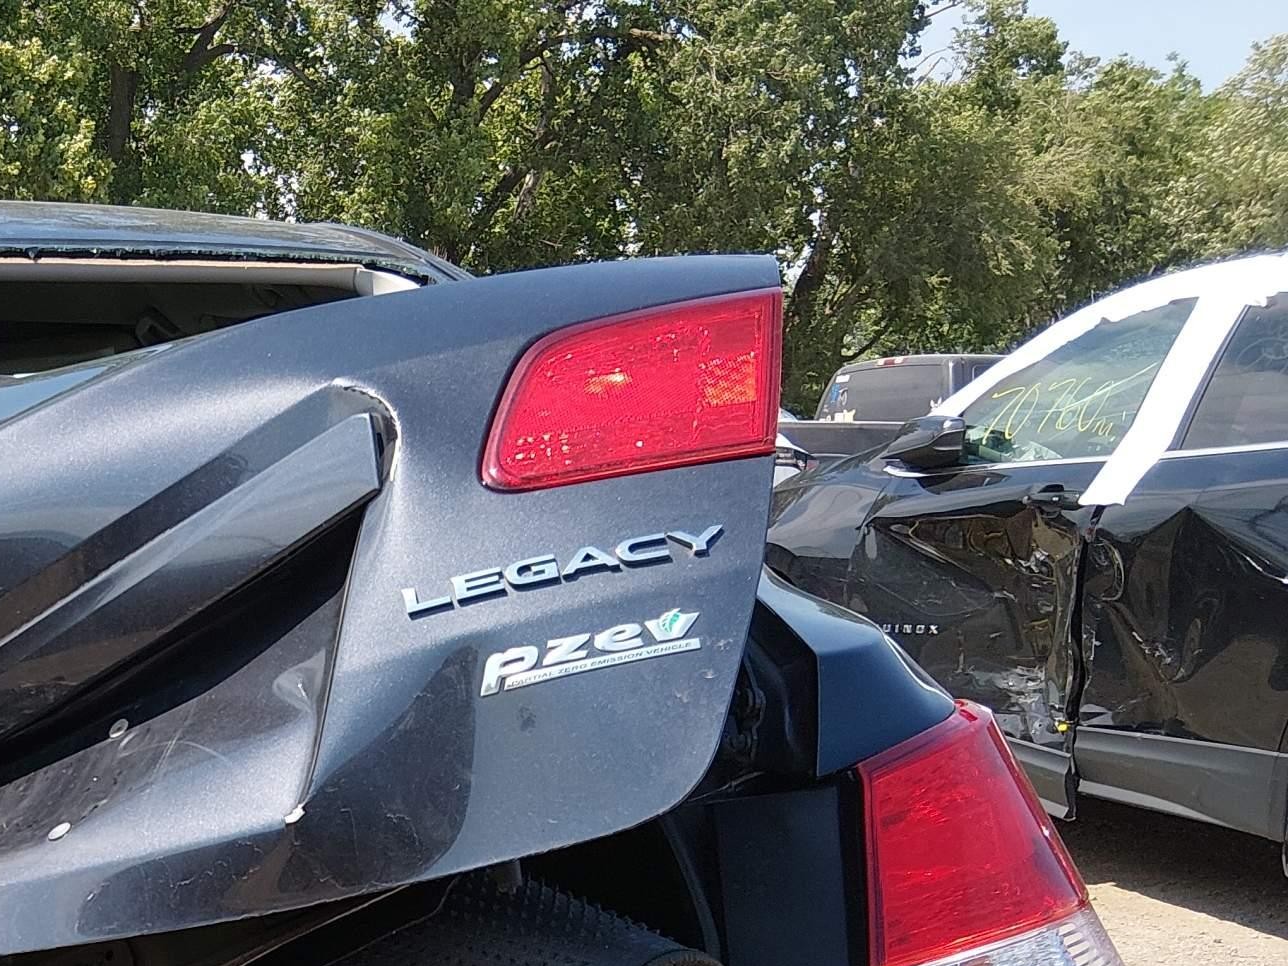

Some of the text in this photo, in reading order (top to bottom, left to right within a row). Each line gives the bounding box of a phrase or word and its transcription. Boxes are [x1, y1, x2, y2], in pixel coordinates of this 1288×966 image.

[401, 524, 724, 620] LEGACY
[880, 623, 939, 635] UINOX
[557, 662, 588, 675] ZERO
[589, 651, 643, 667] EMISSION
[645, 642, 693, 655] VEHICLE
